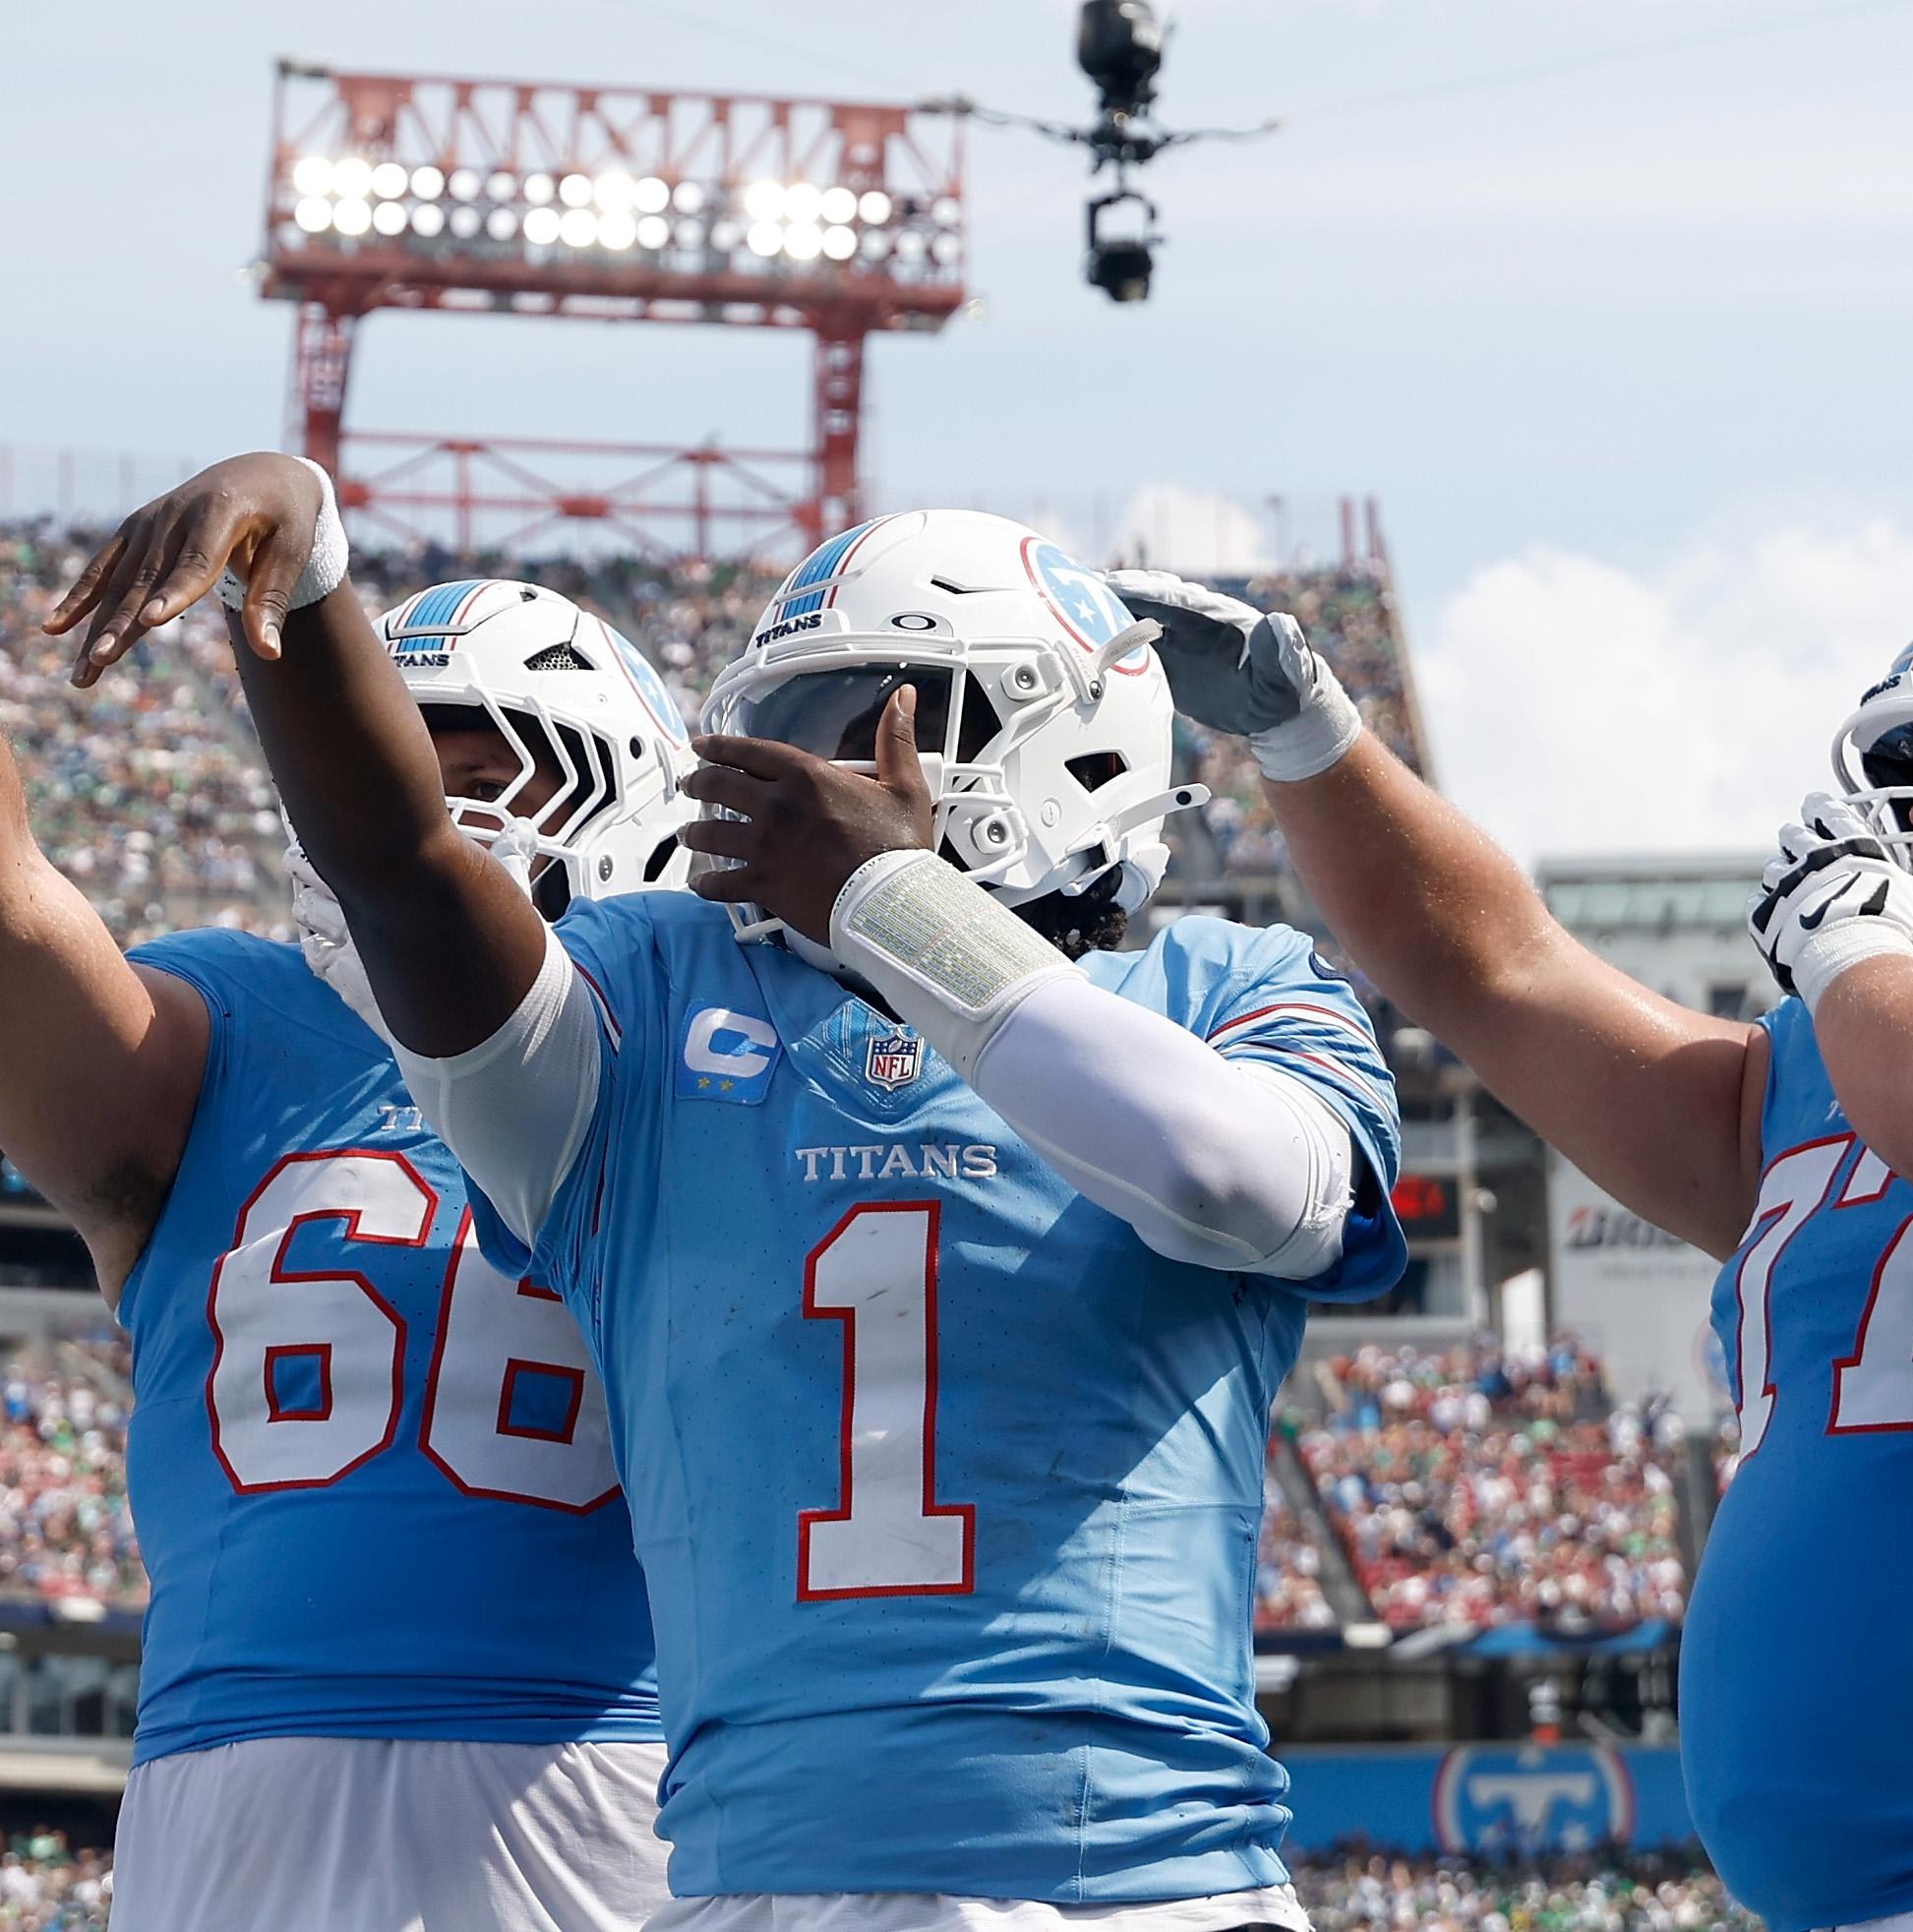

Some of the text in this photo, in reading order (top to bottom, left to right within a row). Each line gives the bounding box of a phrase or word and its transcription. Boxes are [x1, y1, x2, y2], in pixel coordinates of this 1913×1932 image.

[755, 613, 822, 648] TITANS
[392, 653, 450, 668] TANS
[684, 1007, 778, 1078] C
[873, 1055, 910, 1080] NFL
[795, 1144, 998, 1181] TITANS
[206, 1147, 624, 1517] 66
[797, 1199, 976, 1601] 1
